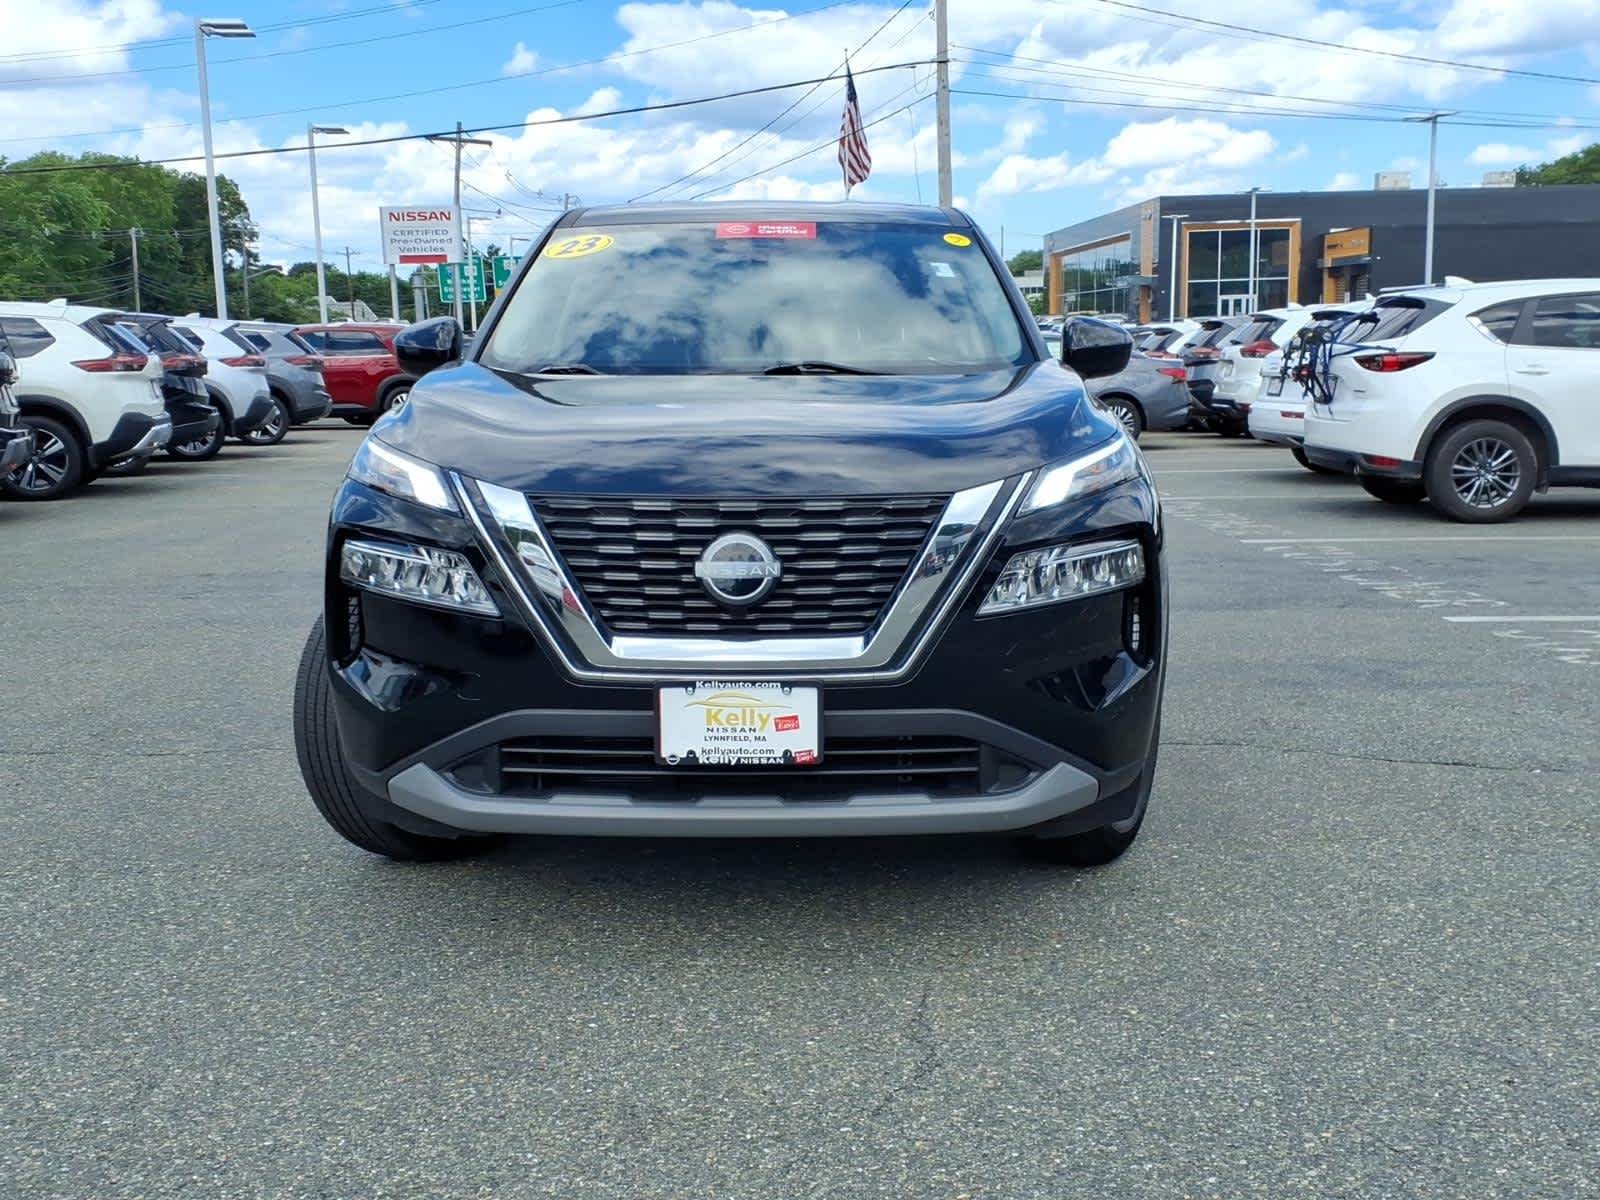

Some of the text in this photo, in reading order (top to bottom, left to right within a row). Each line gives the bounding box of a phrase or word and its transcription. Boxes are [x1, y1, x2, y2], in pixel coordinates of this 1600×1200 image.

[388, 211, 452, 222] NISSAN
[554, 236, 603, 256] 23
[695, 680, 782, 689] Kellyauto.com
[705, 707, 771, 733] Kelly
[704, 735, 752, 743] LYNNFIELD,
[701, 746, 776, 756] kellyauto.com
[698, 755, 739, 766] Kelly
[740, 757, 784, 765] NISSAN
